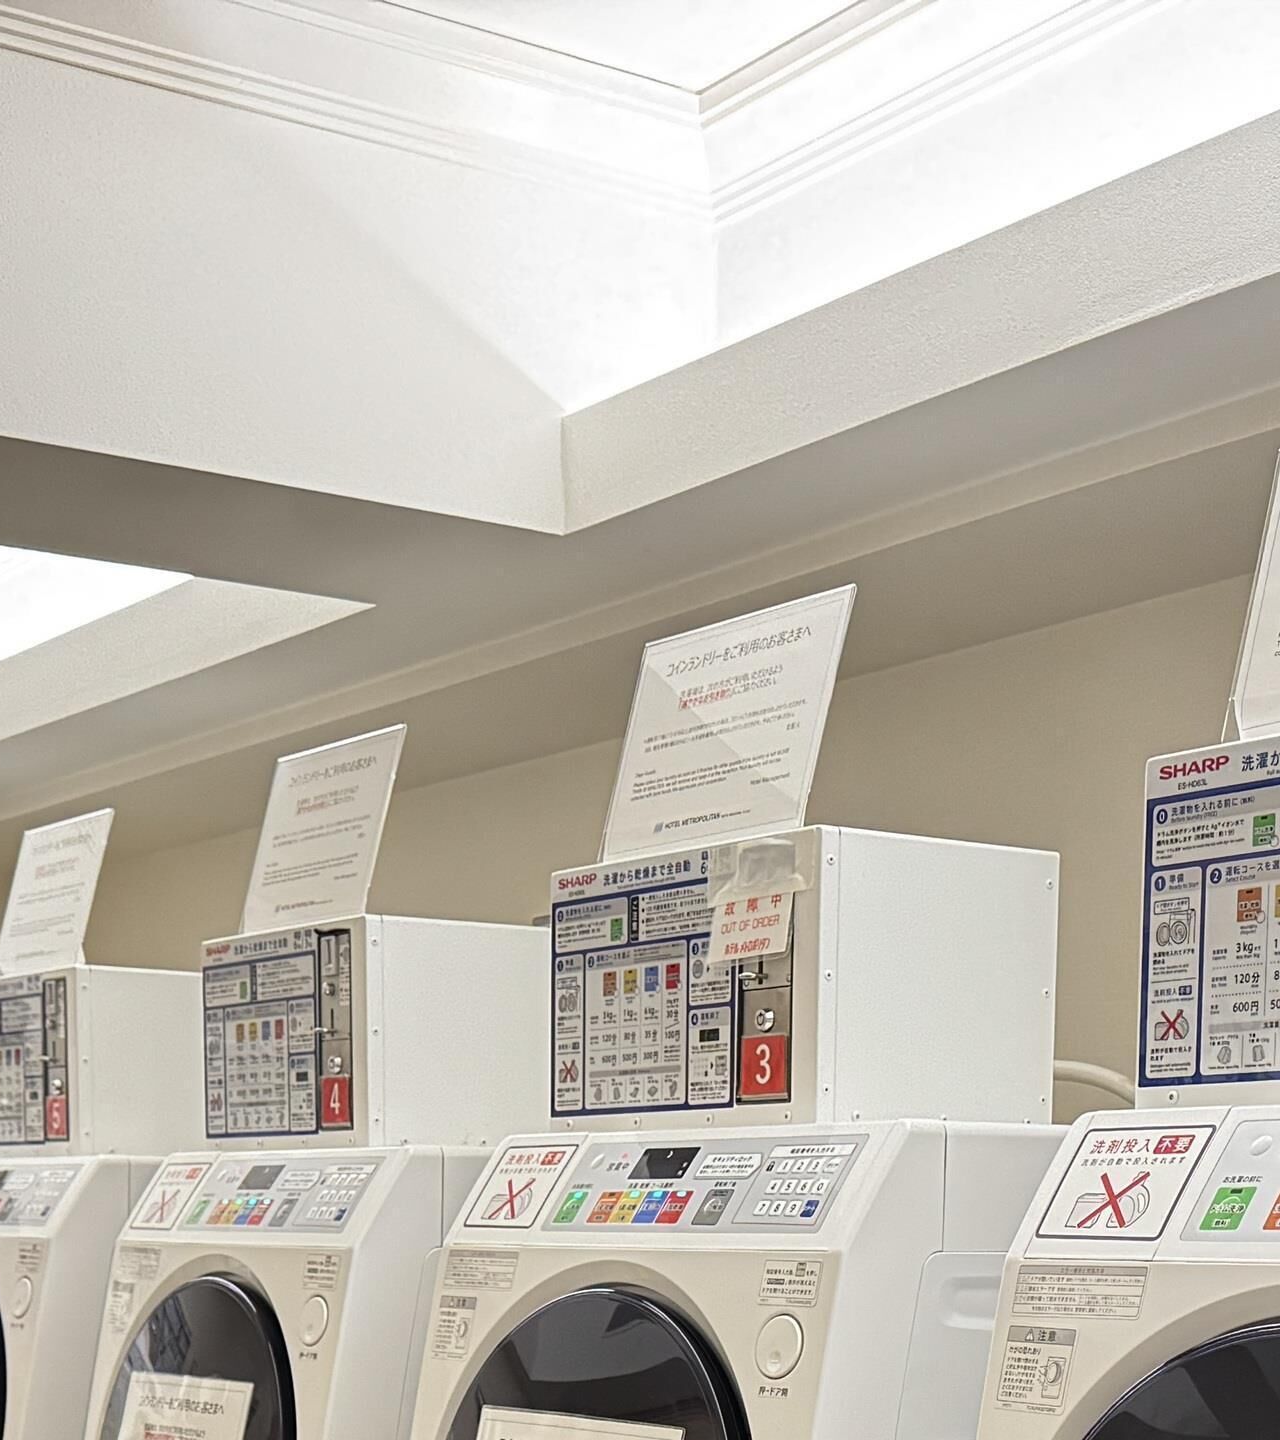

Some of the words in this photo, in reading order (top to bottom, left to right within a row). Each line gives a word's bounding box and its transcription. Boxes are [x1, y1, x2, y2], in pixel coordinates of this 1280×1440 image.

[1159, 755, 1230, 780] SHARP
[558, 873, 597, 890] SHARP
[721, 922, 736, 935] OUT
[739, 919, 750, 931] OF
[752, 914, 780, 929] ORDER
[1234, 972, 1260, 984] 120分
[1232, 1001, 1259, 1013] 600円
[755, 1043, 772, 1085] 3
[329, 1082, 341, 1116] 4
[52, 1103, 61, 1131] 5
[1090, 1138, 1152, 1154] 洗剤投入
[1158, 1136, 1194, 1153] 不要
[1080, 1155, 1187, 1167] 洗剤が自動で投入されます
[1037, 1329, 1057, 1342] 注意
